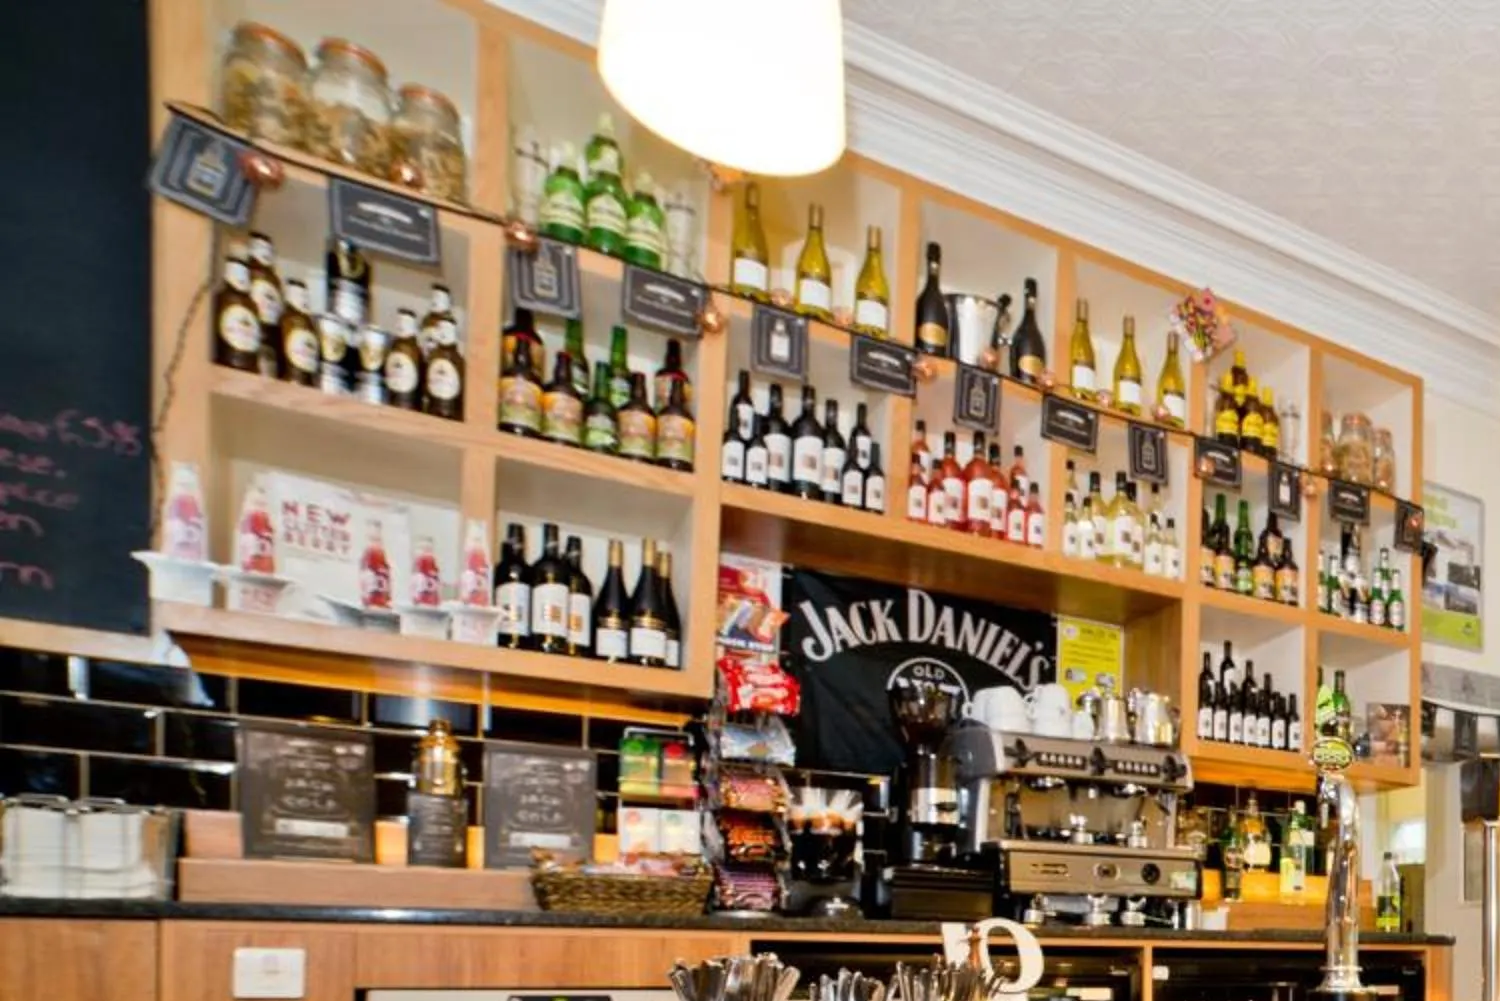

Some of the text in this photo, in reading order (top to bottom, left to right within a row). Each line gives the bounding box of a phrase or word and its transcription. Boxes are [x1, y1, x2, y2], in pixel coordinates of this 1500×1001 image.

[282, 501, 351, 526] NEW
[799, 588, 1050, 692] JACK DANIEL'S
[912, 663, 945, 679] OLD
